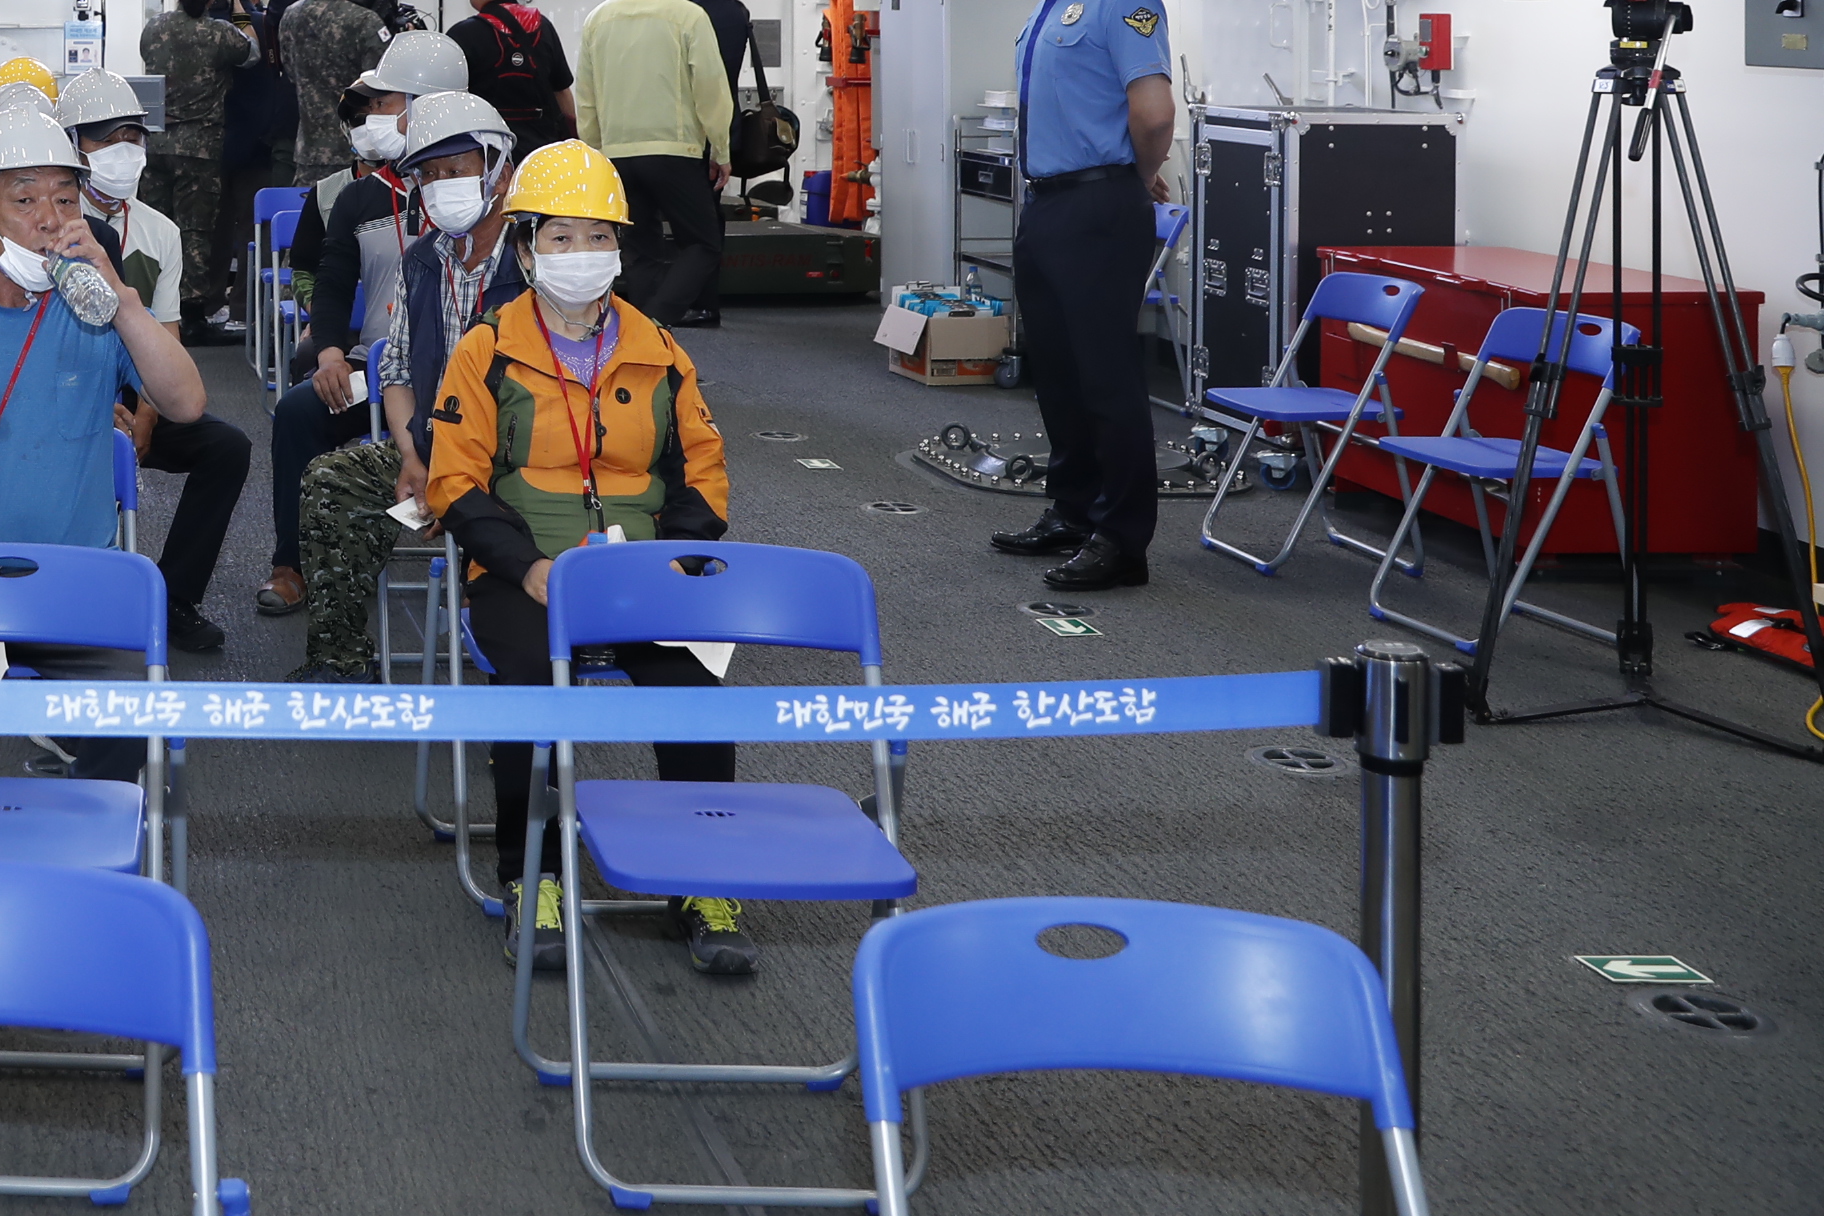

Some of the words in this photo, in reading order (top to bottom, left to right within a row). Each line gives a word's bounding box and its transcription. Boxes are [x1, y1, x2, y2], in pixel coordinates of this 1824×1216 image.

[45, 691, 188, 734] 대한민국
[202, 692, 267, 732] 해군
[286, 690, 436, 732] 한산도함
[774, 693, 916, 733] 대한민국
[930, 691, 998, 730] 해군
[1012, 686, 1159, 729] 한산도함
